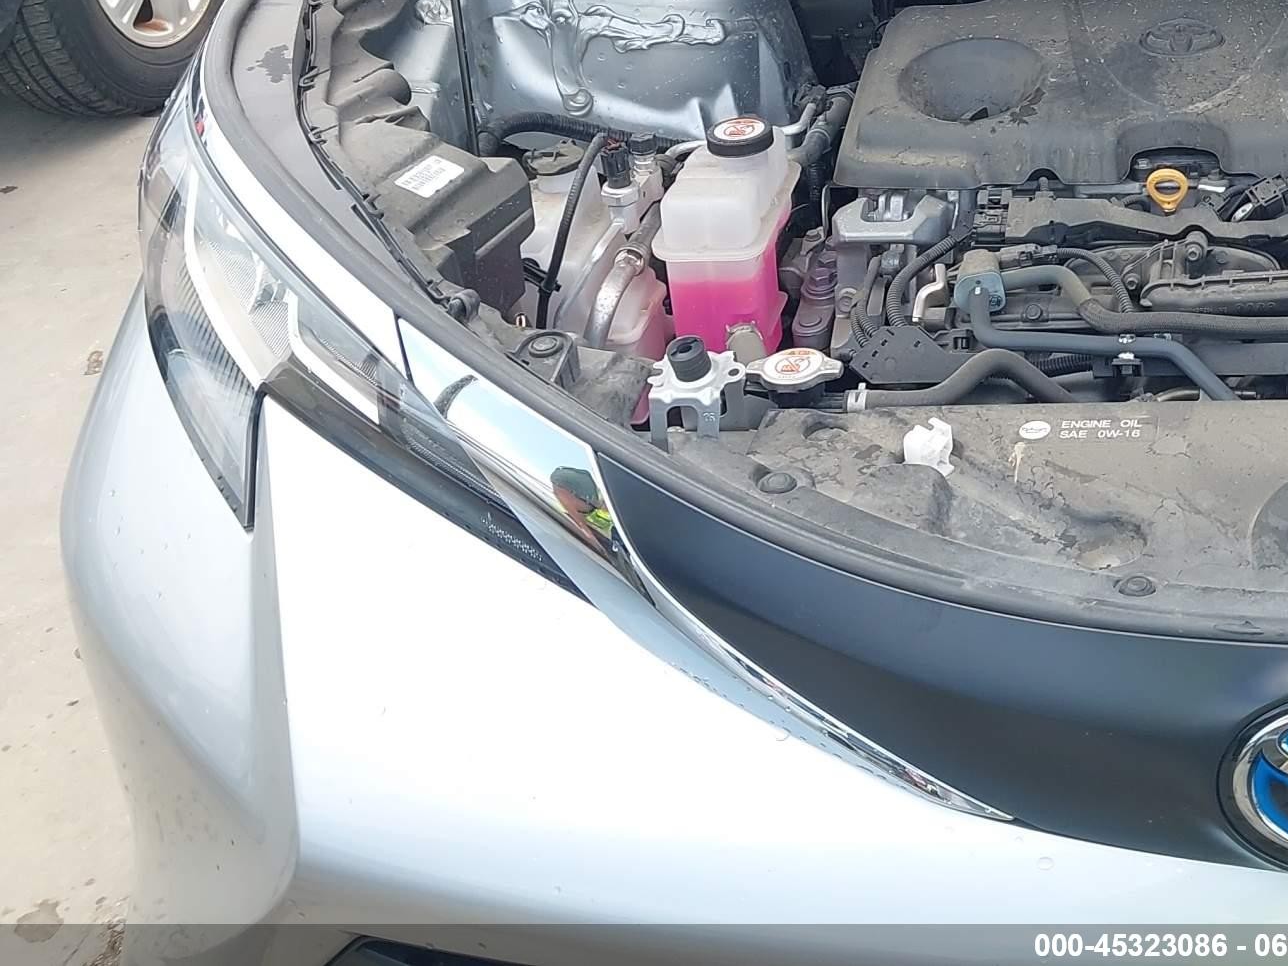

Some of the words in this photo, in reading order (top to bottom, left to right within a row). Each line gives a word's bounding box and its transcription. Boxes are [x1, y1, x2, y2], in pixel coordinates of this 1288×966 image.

[1061, 419, 1112, 428] ENGINE
[1119, 419, 1143, 428] OIL
[1059, 429, 1089, 439] SAE
